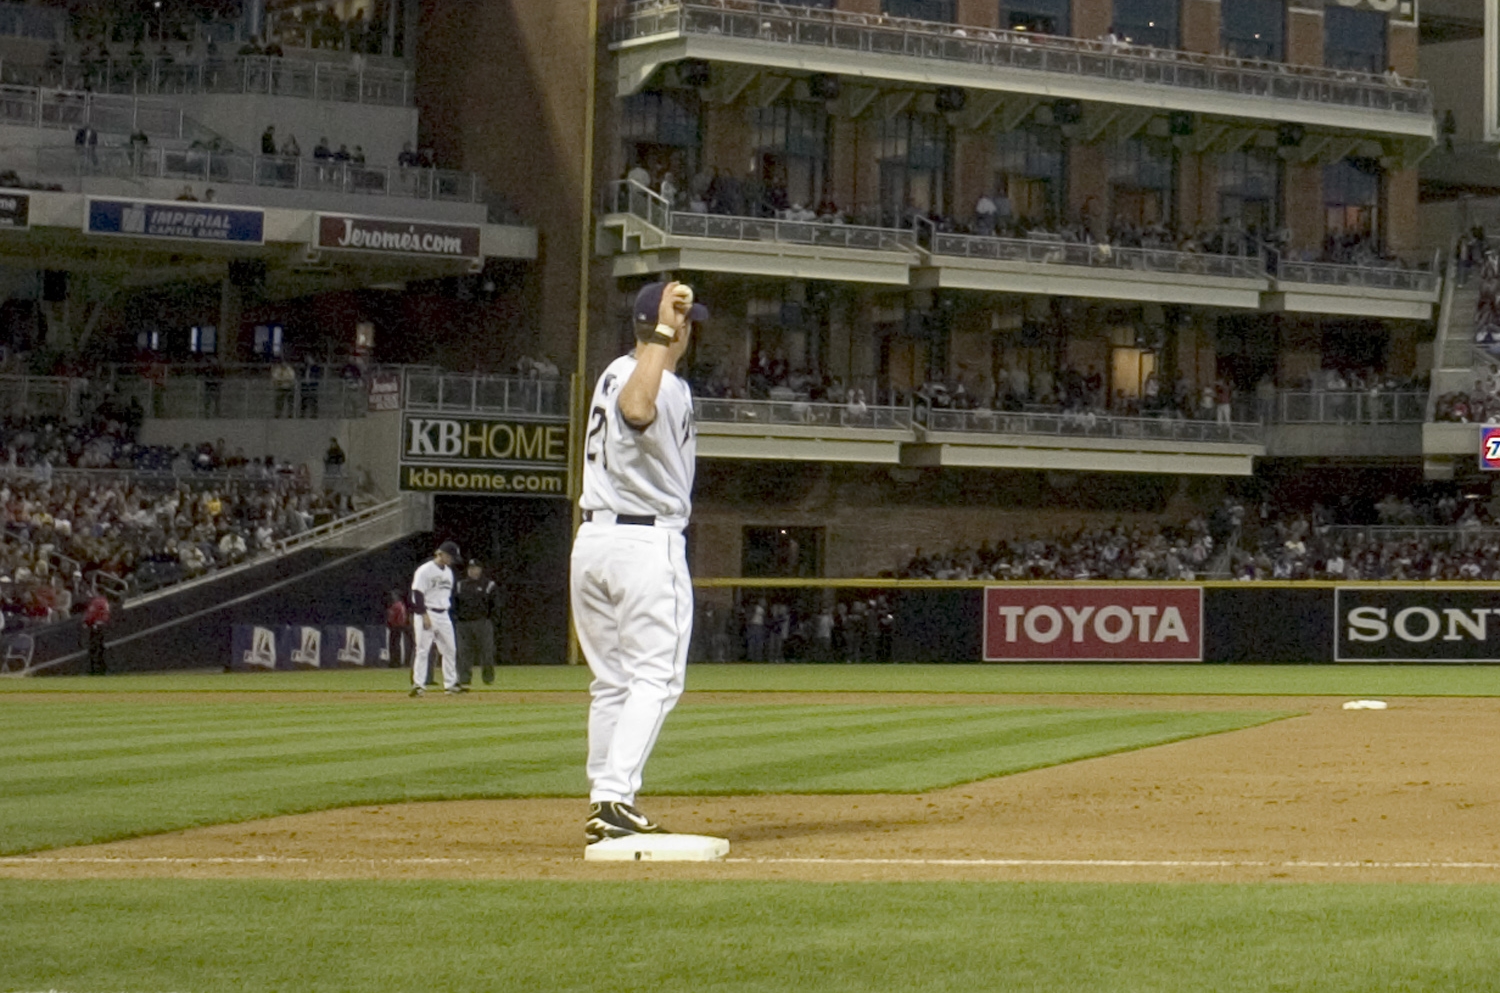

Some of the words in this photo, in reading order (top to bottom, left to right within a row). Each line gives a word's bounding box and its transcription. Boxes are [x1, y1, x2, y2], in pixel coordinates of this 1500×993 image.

[149, 225, 195, 236] CAPITAL
[150, 210, 231, 229] IMPERIAL
[338, 219, 463, 253] Jerome's.com
[408, 469, 562, 491] kbhome.com
[999, 606, 1189, 643] TOYOTA
